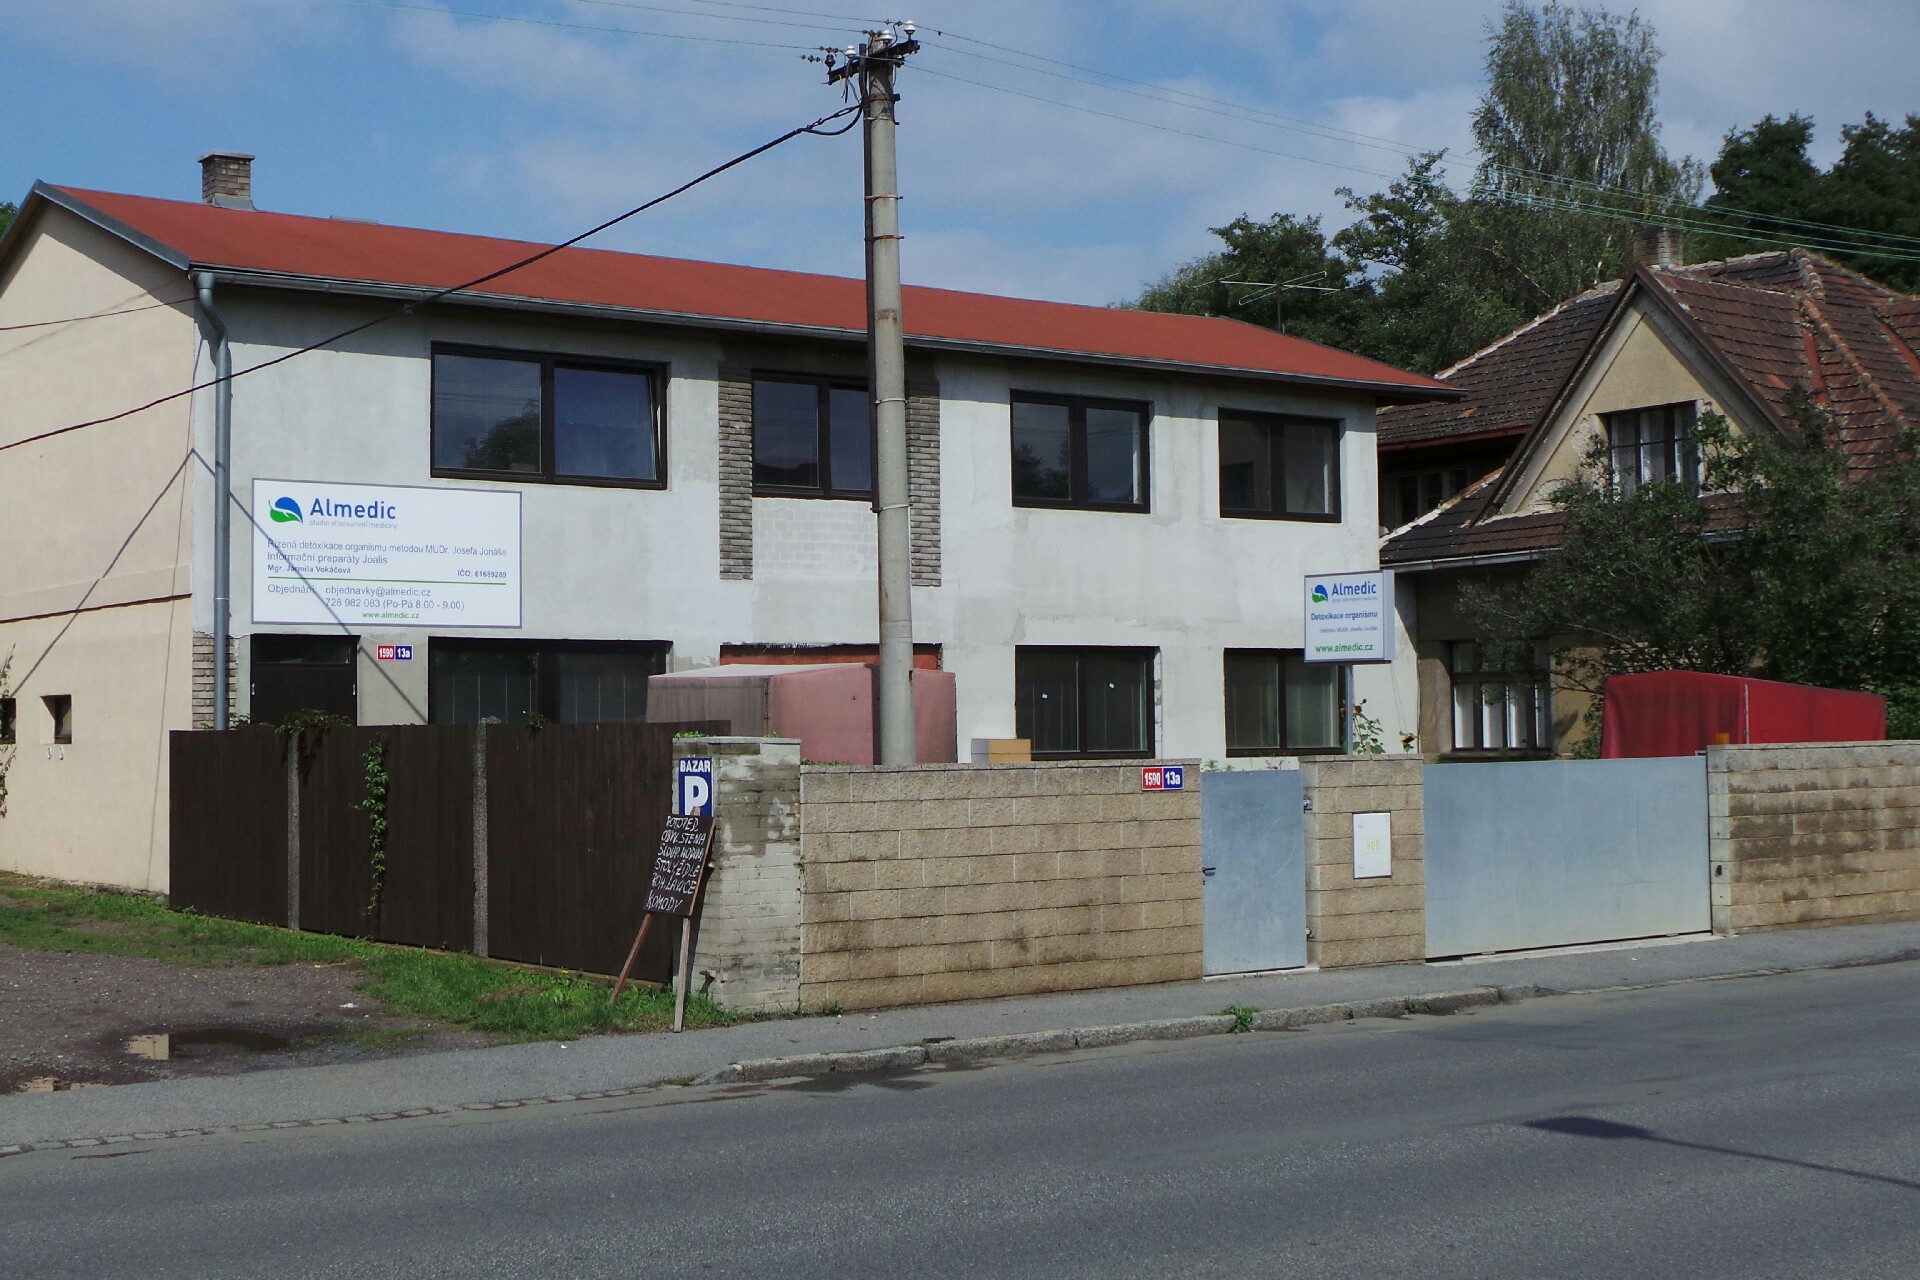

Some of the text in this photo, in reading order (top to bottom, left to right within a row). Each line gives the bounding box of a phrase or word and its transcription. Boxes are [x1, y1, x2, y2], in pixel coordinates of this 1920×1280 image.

[310, 498, 396, 519] Almedic
[300, 540, 343, 550] detoxikace
[346, 543, 387, 552] organismu
[390, 545, 424, 554] metodou
[426, 544, 449, 554] MUDr.
[453, 546, 478, 556] Josefa
[267, 552, 388, 565] Informační preparáty Joalis
[267, 564, 284, 573] Mgr.
[326, 585, 431, 598] objednavky@almedic.cz
[1331, 581, 1377, 596] Almedic
[326, 598, 342, 607] 728
[344, 598, 361, 608] 982
[364, 599, 380, 608] 083
[382, 600, 413, 610] (Po-Pá
[415, 600, 434, 609] 8.00
[442, 600, 465, 611] 9.00)
[362, 612, 420, 620] www.almedic.cz
[1310, 610, 1378, 620] Detoxikace organismu
[379, 648, 394, 658] 1590
[397, 648, 410, 658] 13a
[1315, 642, 1374, 653] www.almedic.cz
[680, 760, 711, 772] BAZAR
[1144, 772, 1161, 786] 1590
[1165, 771, 1181, 786] 13a
[684, 776, 708, 816] P
[646, 890, 684, 912] KOMODY
